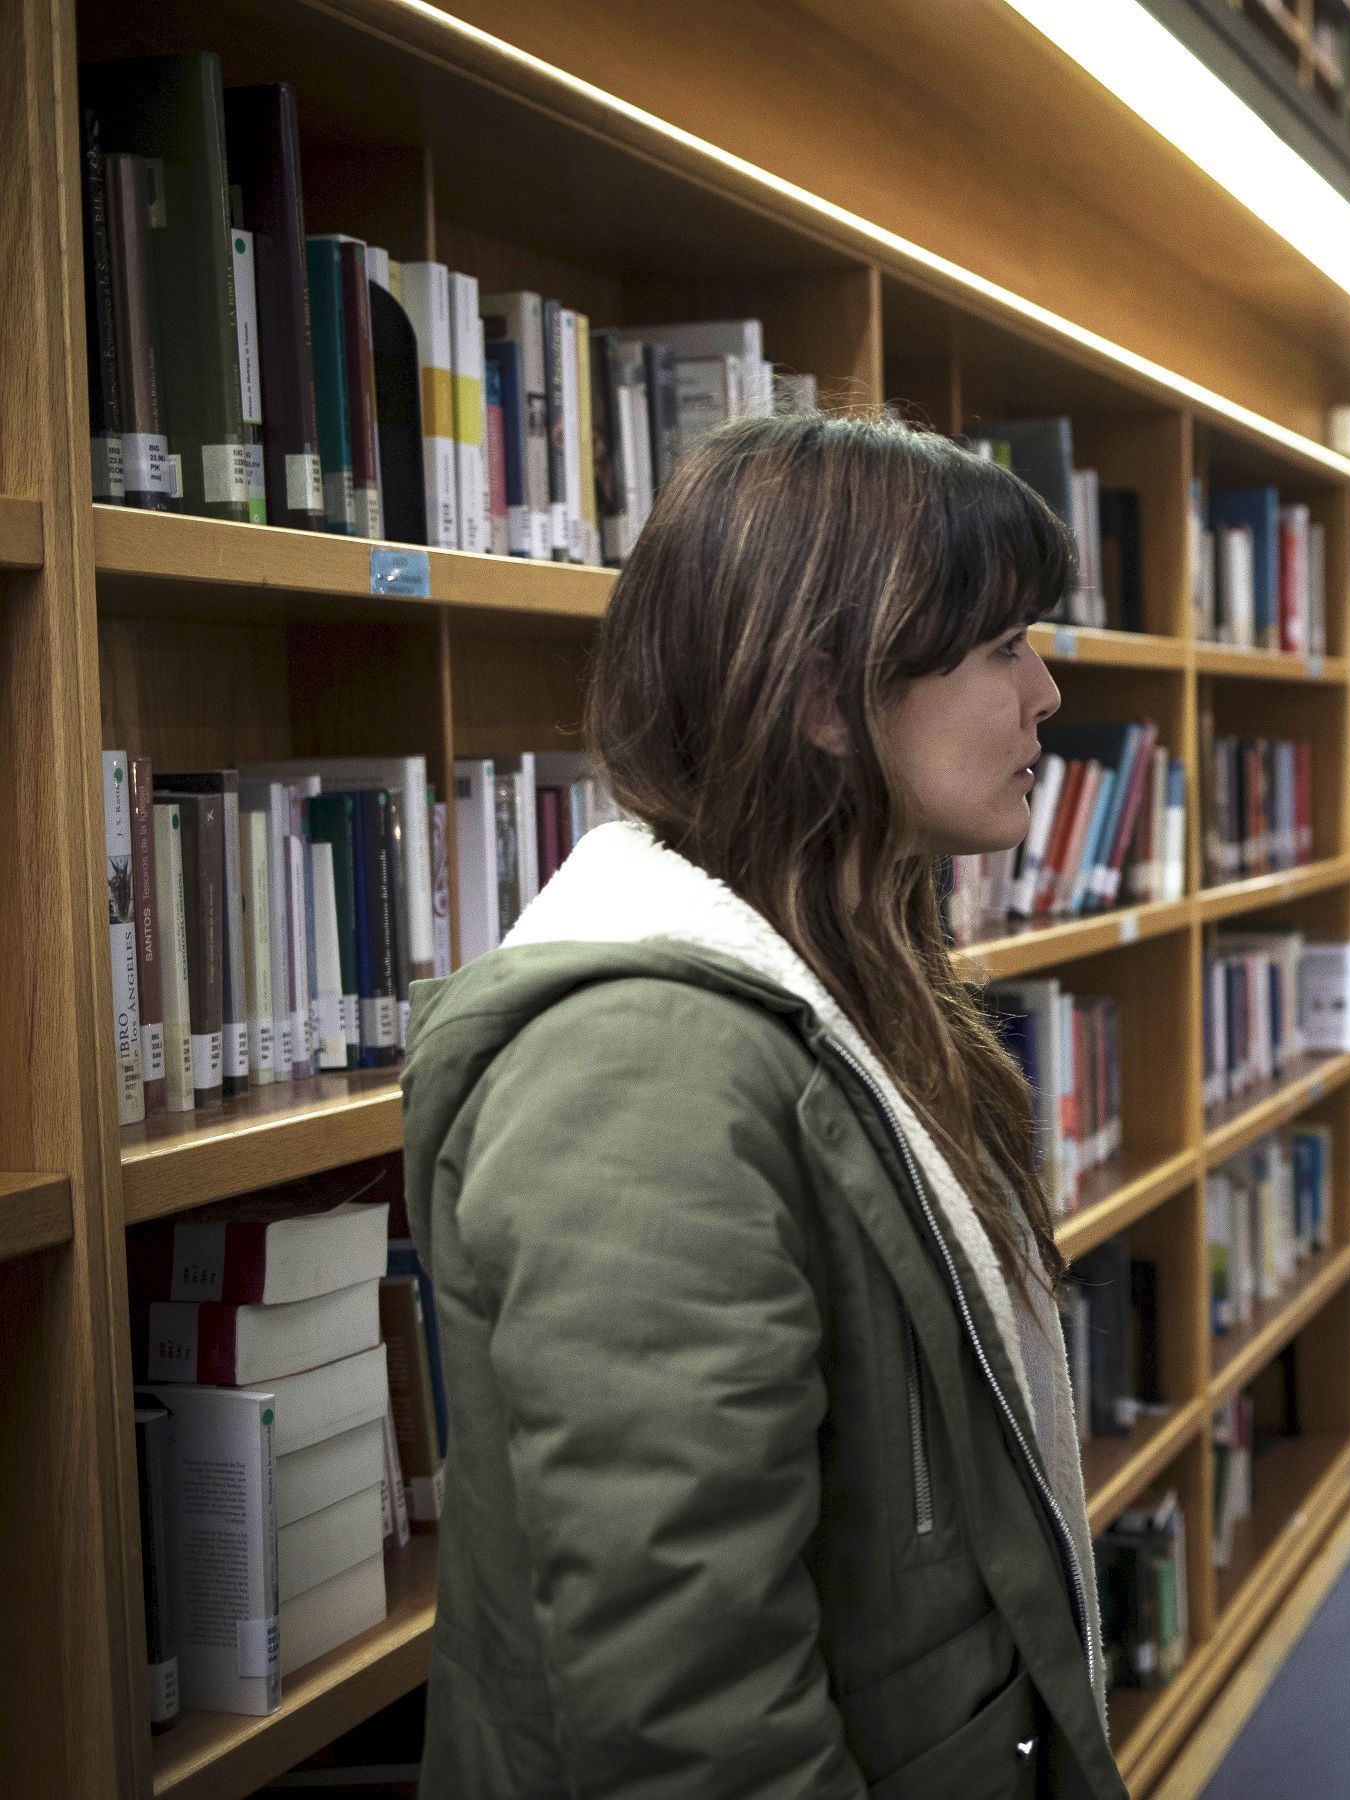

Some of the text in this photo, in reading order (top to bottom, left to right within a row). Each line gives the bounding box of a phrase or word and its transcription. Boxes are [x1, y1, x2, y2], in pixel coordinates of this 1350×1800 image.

[138, 825, 147, 835] la
[139, 838, 148, 854] de
[141, 857, 151, 901] Tesoros
[124, 931, 138, 1012] ÁNGELES
[118, 1013, 130, 1059] IBRO
[130, 1021, 138, 1043] los
